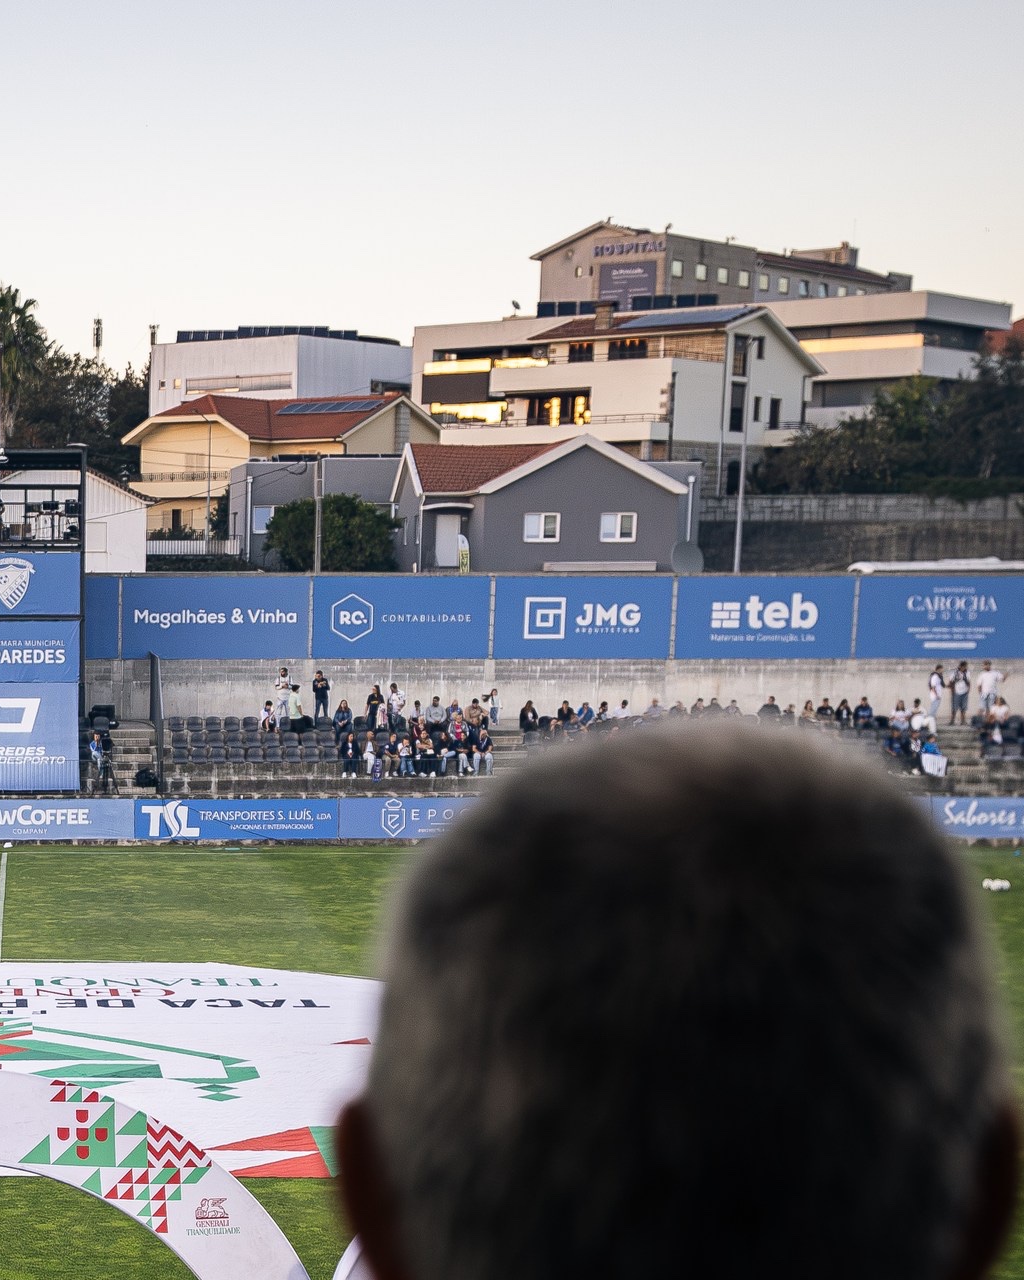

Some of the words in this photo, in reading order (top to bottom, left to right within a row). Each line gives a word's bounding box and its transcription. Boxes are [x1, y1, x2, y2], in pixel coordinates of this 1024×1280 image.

[593, 240, 666, 257] HOSPITAL
[745, 592, 818, 629] teb
[907, 595, 998, 612] CAROCHA
[134, 609, 226, 628] Magalhães
[231, 608, 243, 624] &
[248, 609, 297, 624] Vinha
[381, 614, 472, 623] CONTABILIDADE
[576, 603, 642, 626] JMG
[575, 627, 640, 635] ARQUITETURA
[25, 639, 65, 647] MUNICIPAL
[141, 800, 200, 838] TSL
[199, 810, 275, 821] TRANSPORTES
[278, 810, 286, 821] S.
[289, 808, 314, 822] LUÍS,
[943, 799, 1016, 827] Sabores
[54, 998, 134, 1008] DE
[186, 1227, 241, 1236] TRANQUILIDADE
[195, 1220, 230, 1228] GENERALI
